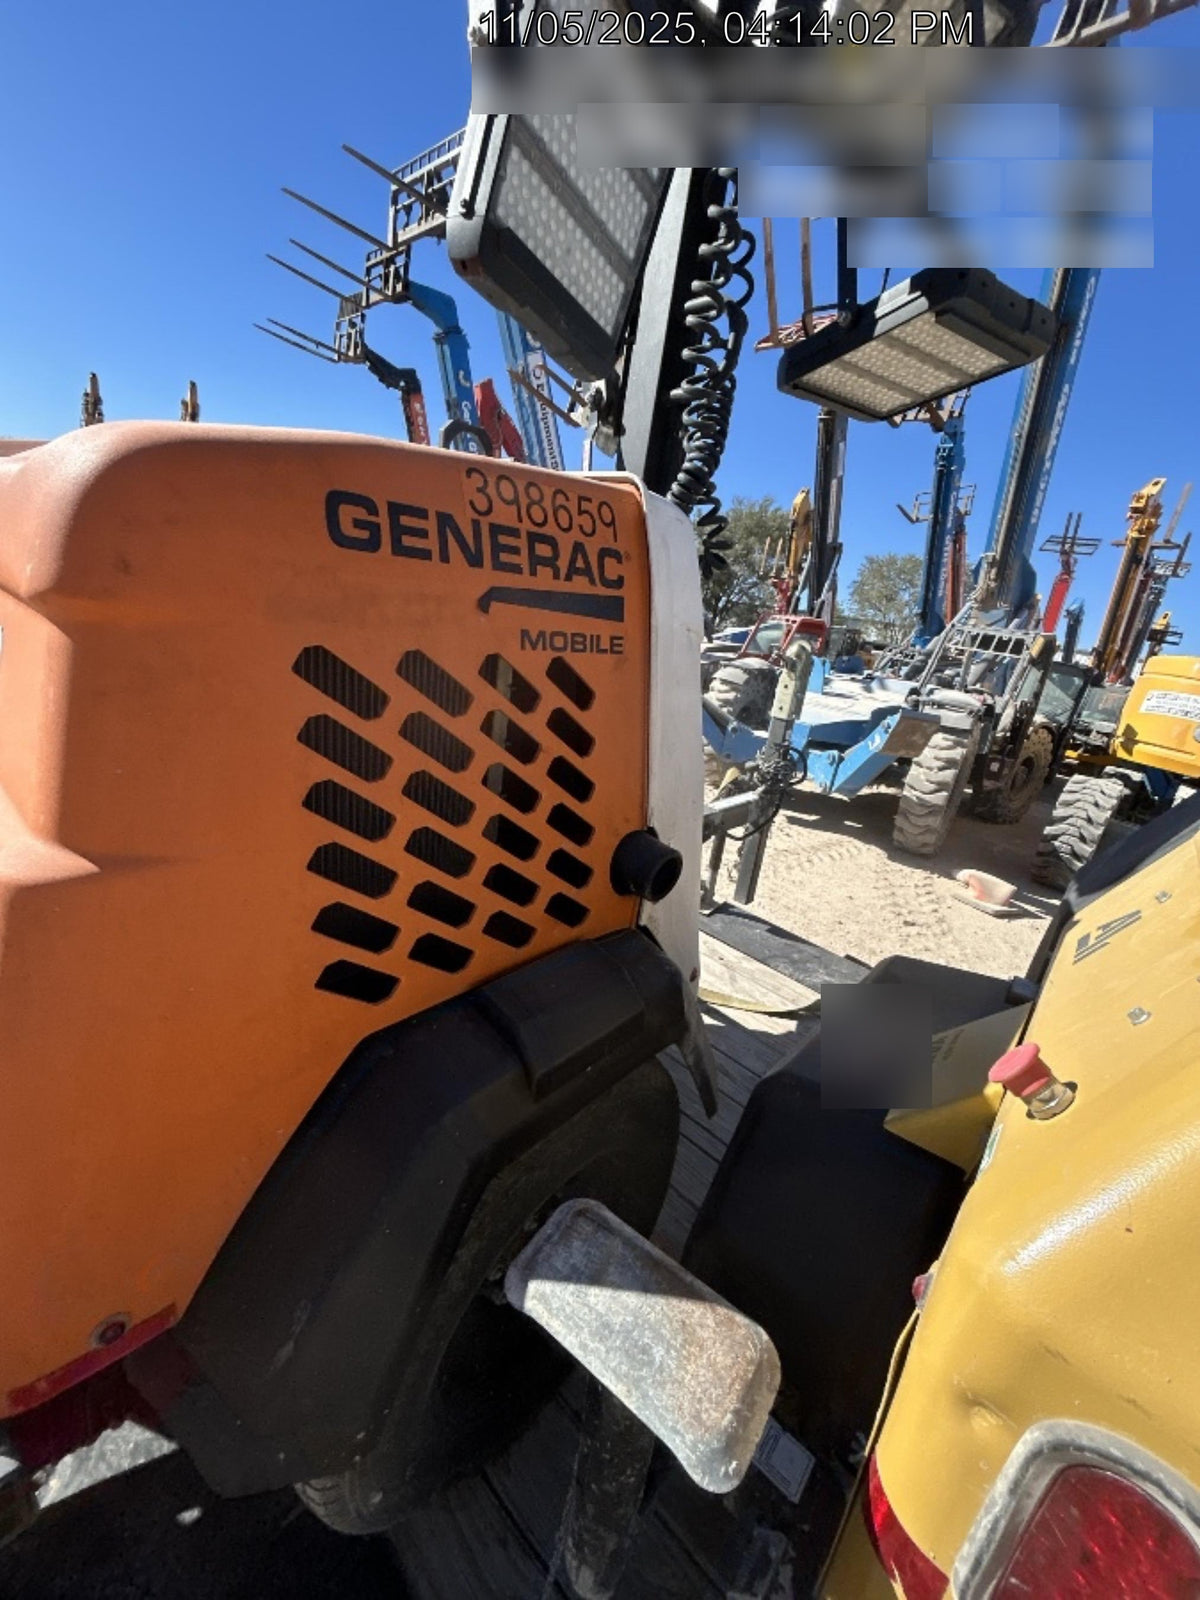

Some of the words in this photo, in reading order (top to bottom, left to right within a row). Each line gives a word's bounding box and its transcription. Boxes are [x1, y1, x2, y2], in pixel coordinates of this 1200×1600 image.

[325, 489, 626, 590] GENERAC
[465, 466, 619, 543] 398659
[520, 628, 624, 655] MOBILE
